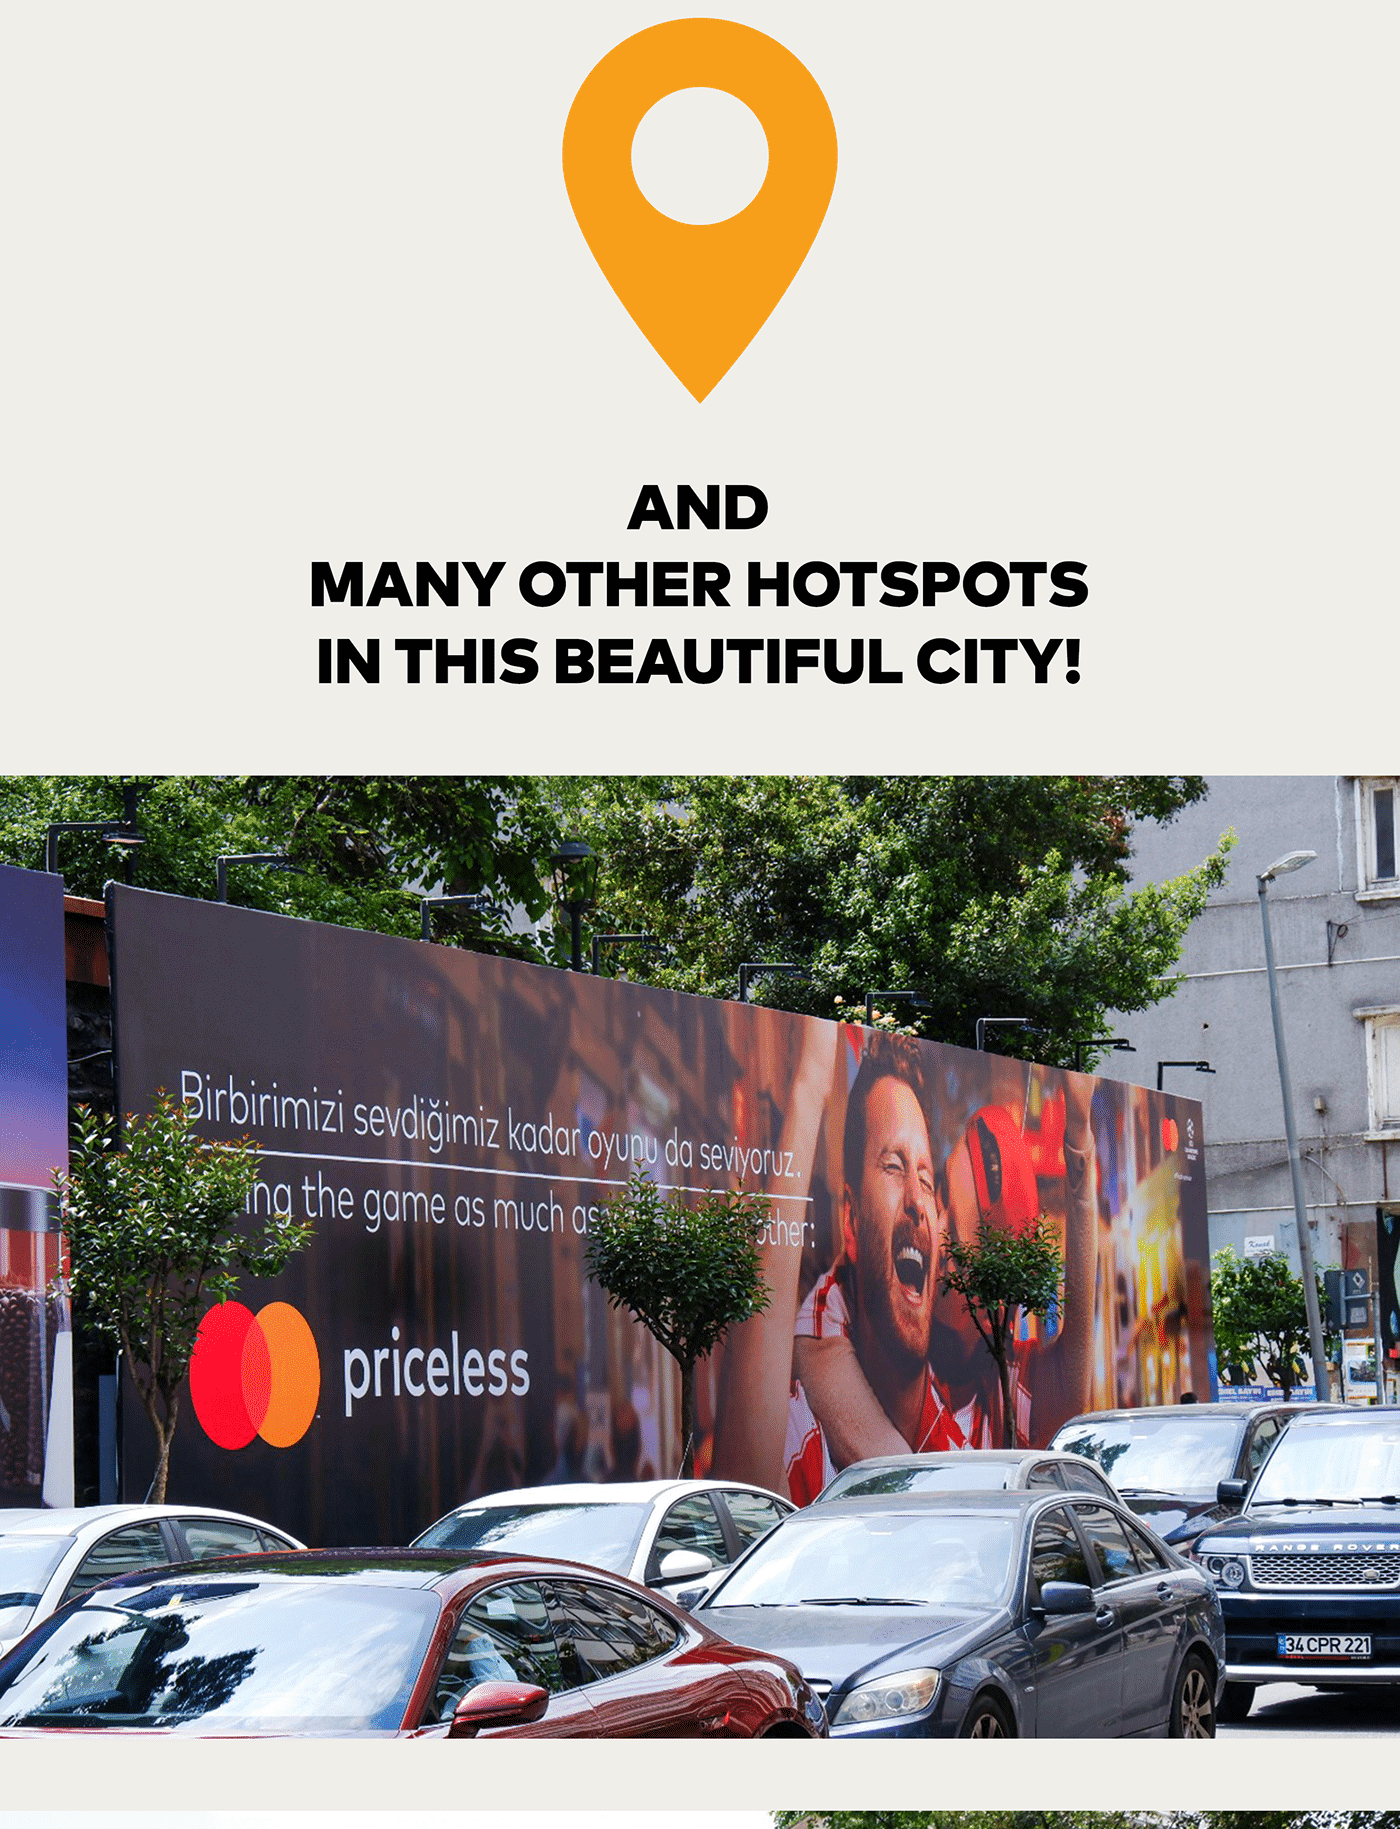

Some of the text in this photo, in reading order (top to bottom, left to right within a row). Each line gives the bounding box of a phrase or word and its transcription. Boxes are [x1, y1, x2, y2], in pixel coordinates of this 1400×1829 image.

[181, 1070, 802, 1179] Birbirimizi sevdiğimiz kadar oyunu da seviyoruz.
[302, 1170, 354, 1220] the
[364, 1187, 446, 1233] game
[454, 1194, 485, 1228] as
[494, 1189, 564, 1233] much
[344, 1325, 531, 1418] priceless
[1286, 1637, 1370, 1653] 34 CPR 221
